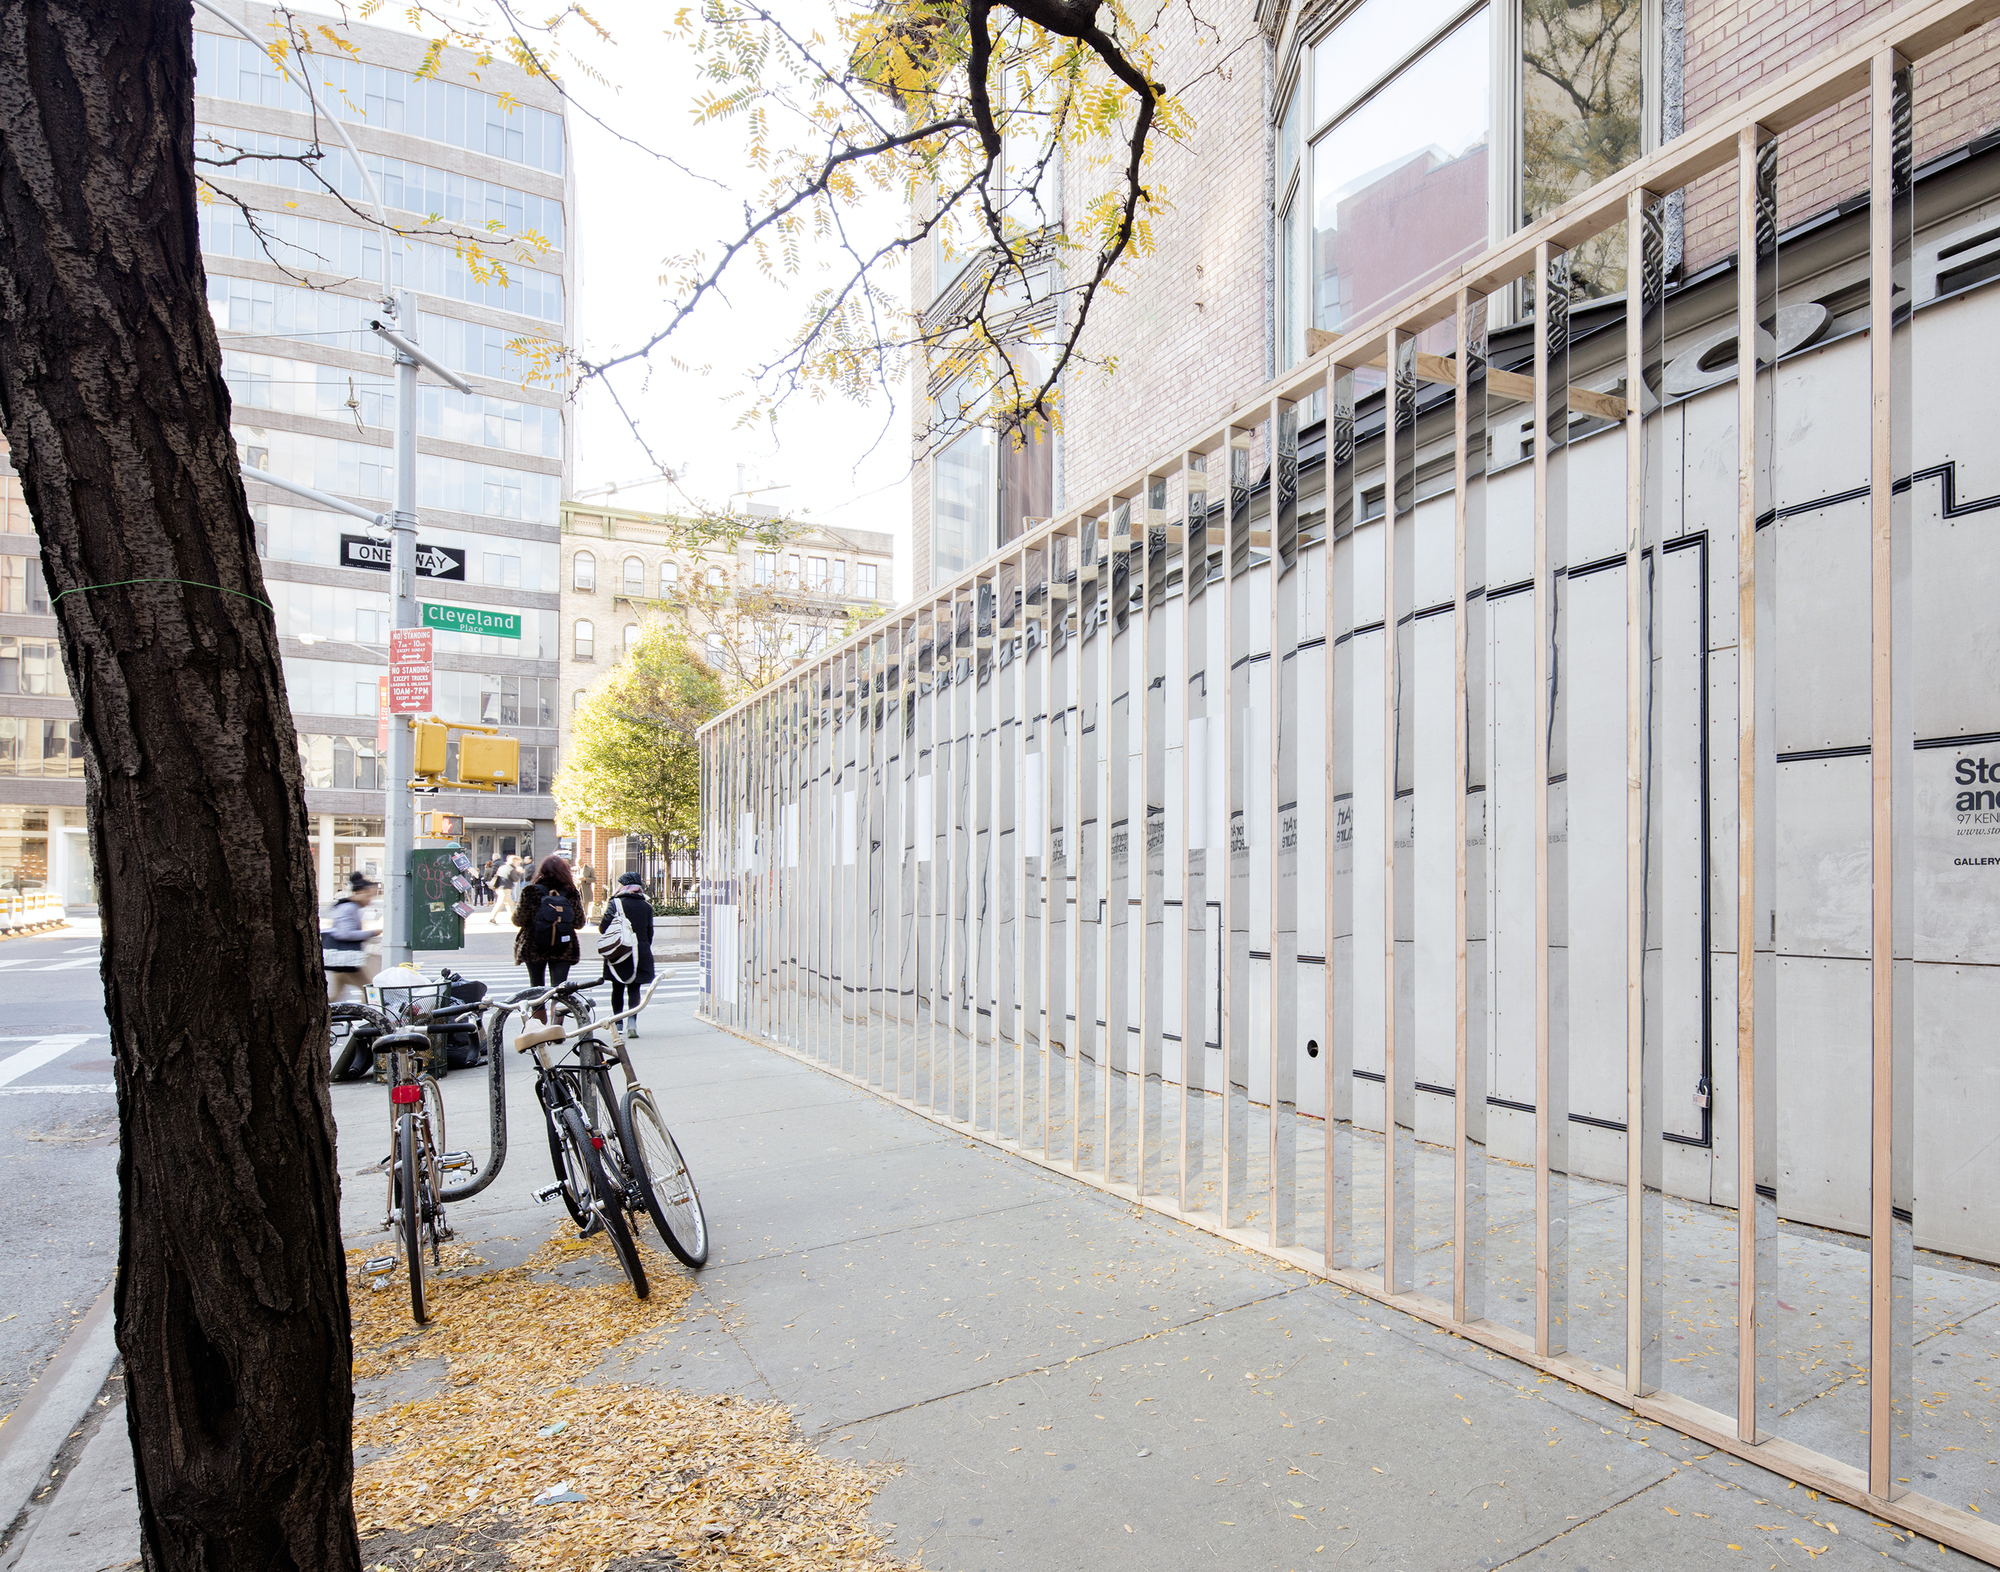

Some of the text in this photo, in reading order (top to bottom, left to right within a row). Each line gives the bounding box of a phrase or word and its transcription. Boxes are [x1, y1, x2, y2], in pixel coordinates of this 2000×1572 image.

[359, 546, 391, 562] ONE
[428, 606, 514, 629] Cleveland
[460, 623, 483, 633] Place
[403, 631, 430, 640] STANDING
[402, 666, 430, 674] STANDING
[1956, 790, 2000, 811] an
[1957, 813, 1971, 824] 97
